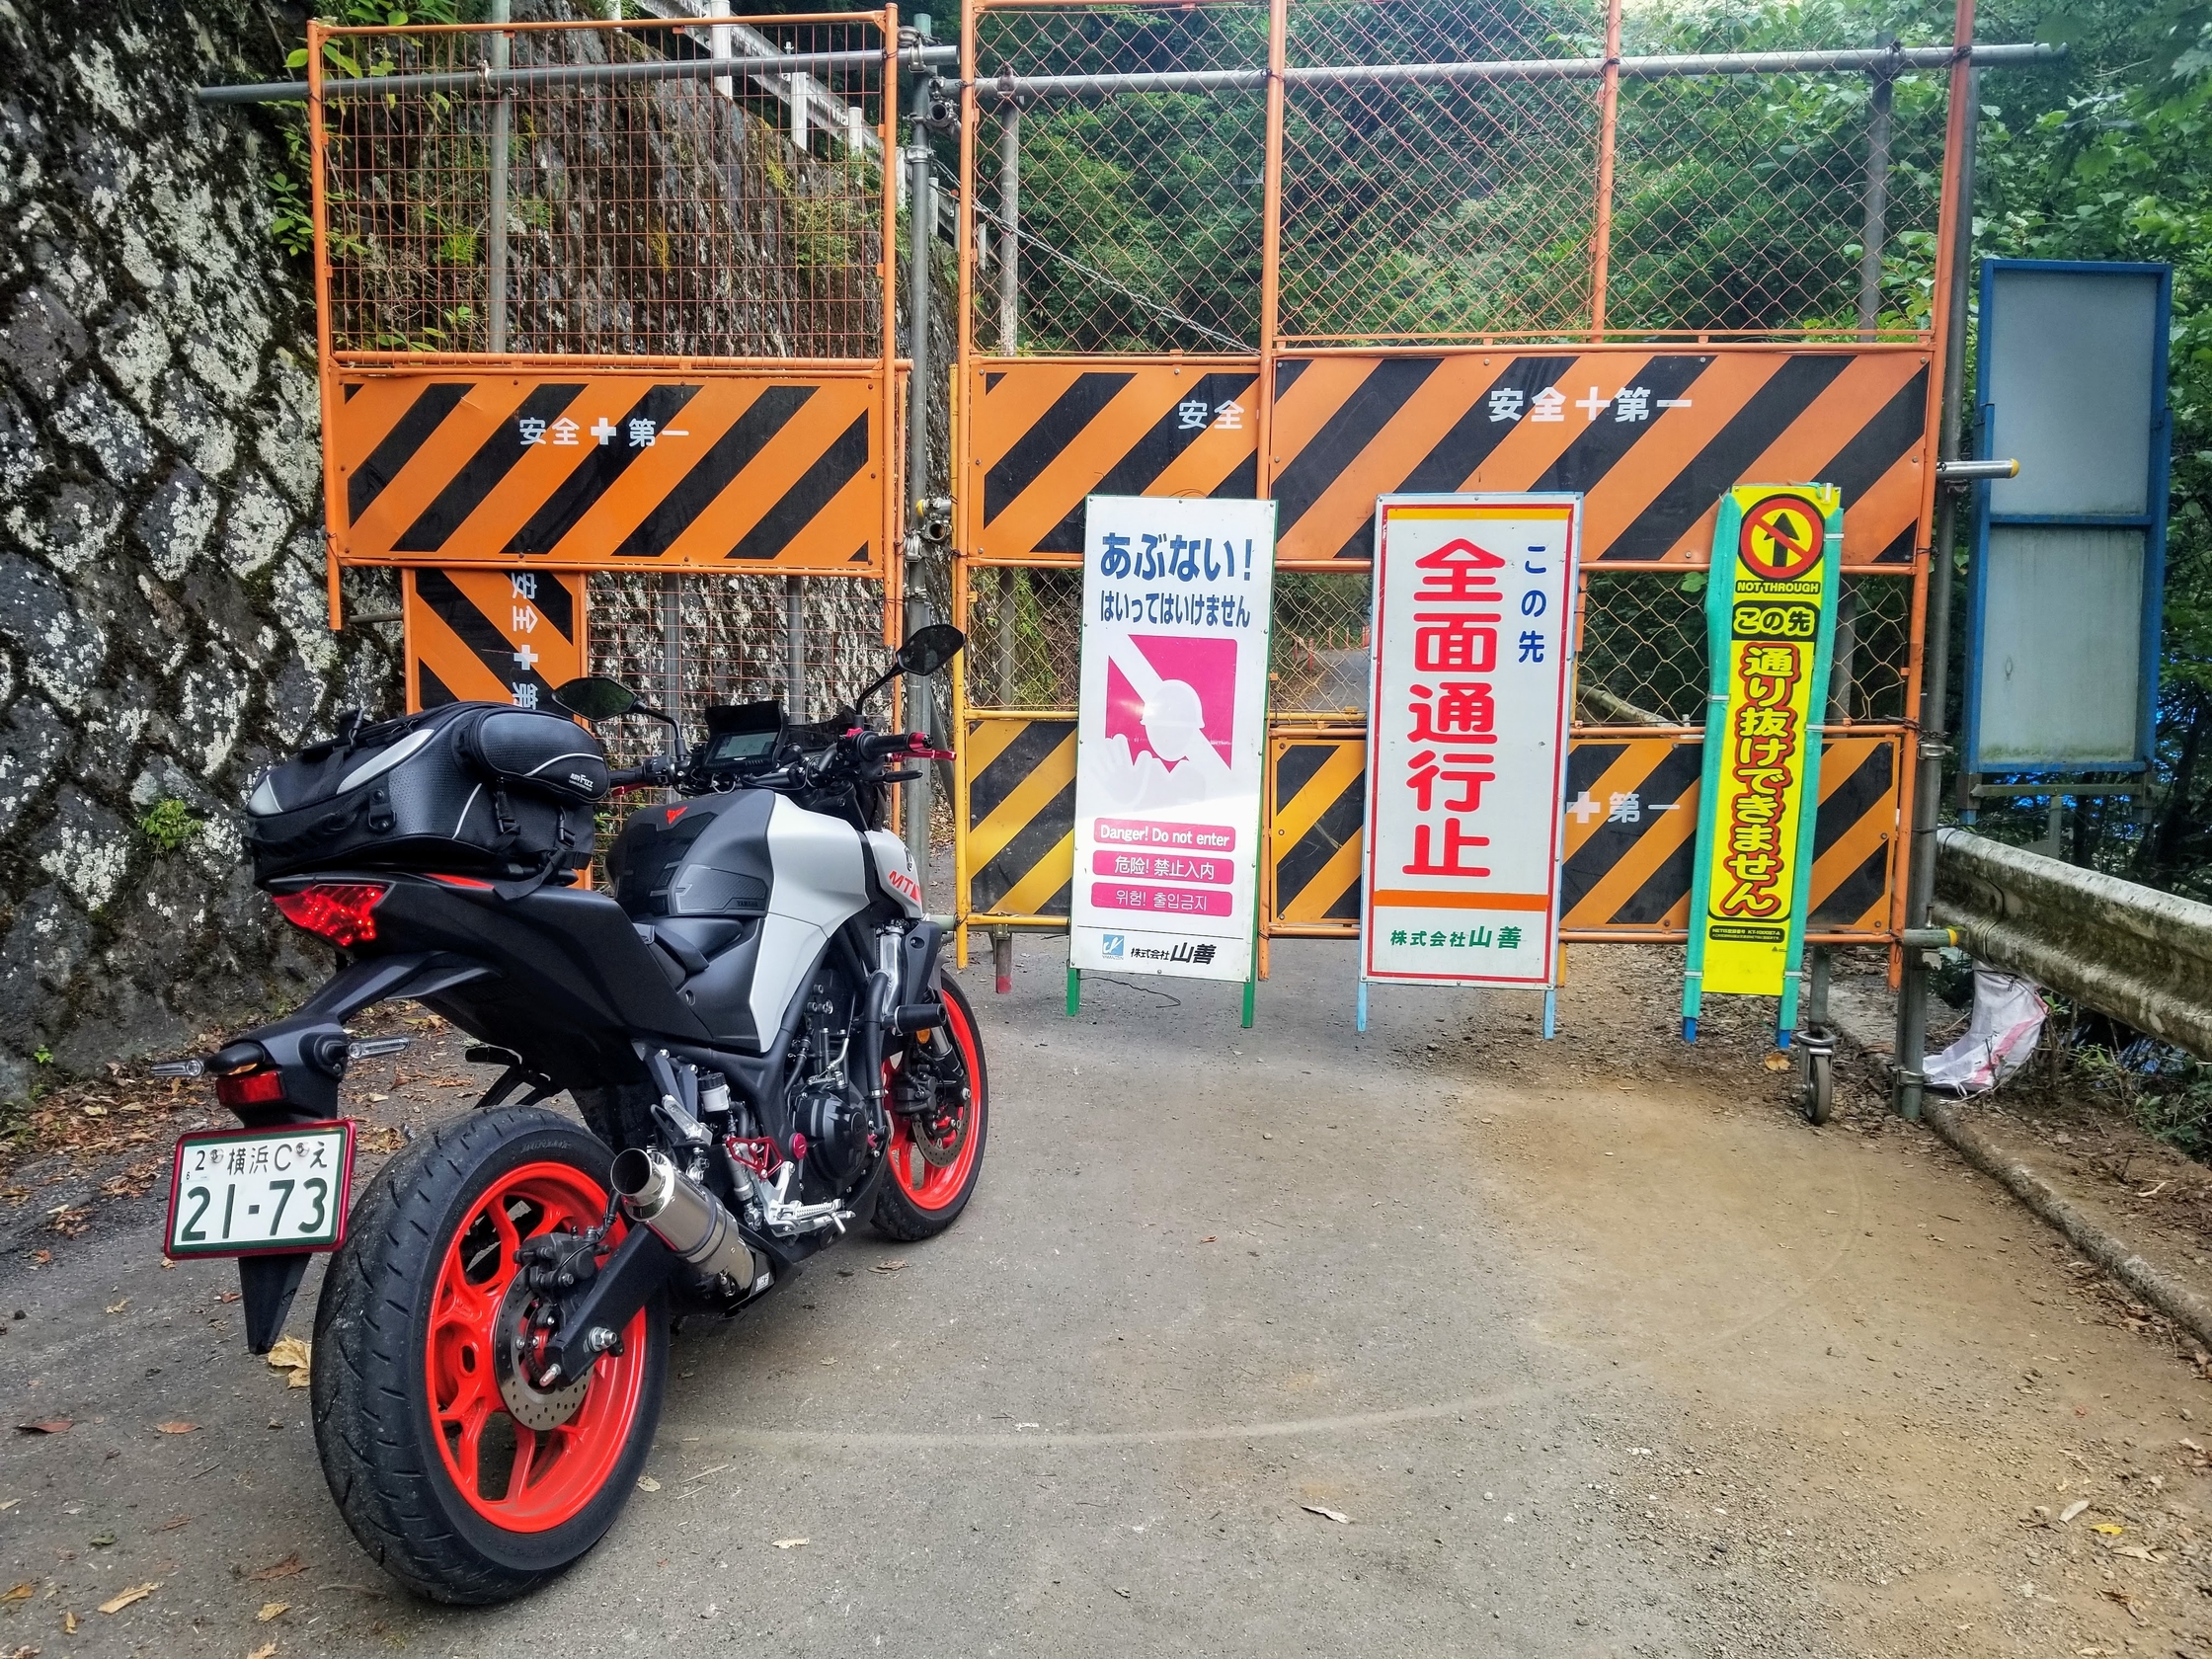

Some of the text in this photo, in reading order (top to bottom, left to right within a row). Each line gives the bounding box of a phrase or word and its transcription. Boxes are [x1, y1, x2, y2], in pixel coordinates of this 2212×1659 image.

[1100, 532, 1253, 582] あぶない!
[1518, 545, 1547, 664] この先
[1736, 581, 1819, 592] NOT THROUGH
[1100, 590, 1251, 628] はいってはいけません
[1735, 608, 1813, 634] この先
[1402, 538, 1506, 877] 全面通行止
[1721, 645, 1797, 913] 通り抜けできません
[1100, 824, 1230, 847] Danger! Do not enter
[1114, 855, 1215, 880] 危险! 禁止入内
[1115, 890, 1207, 910] 위험! 출입금지
[181, 1177, 329, 1242] 21-73
